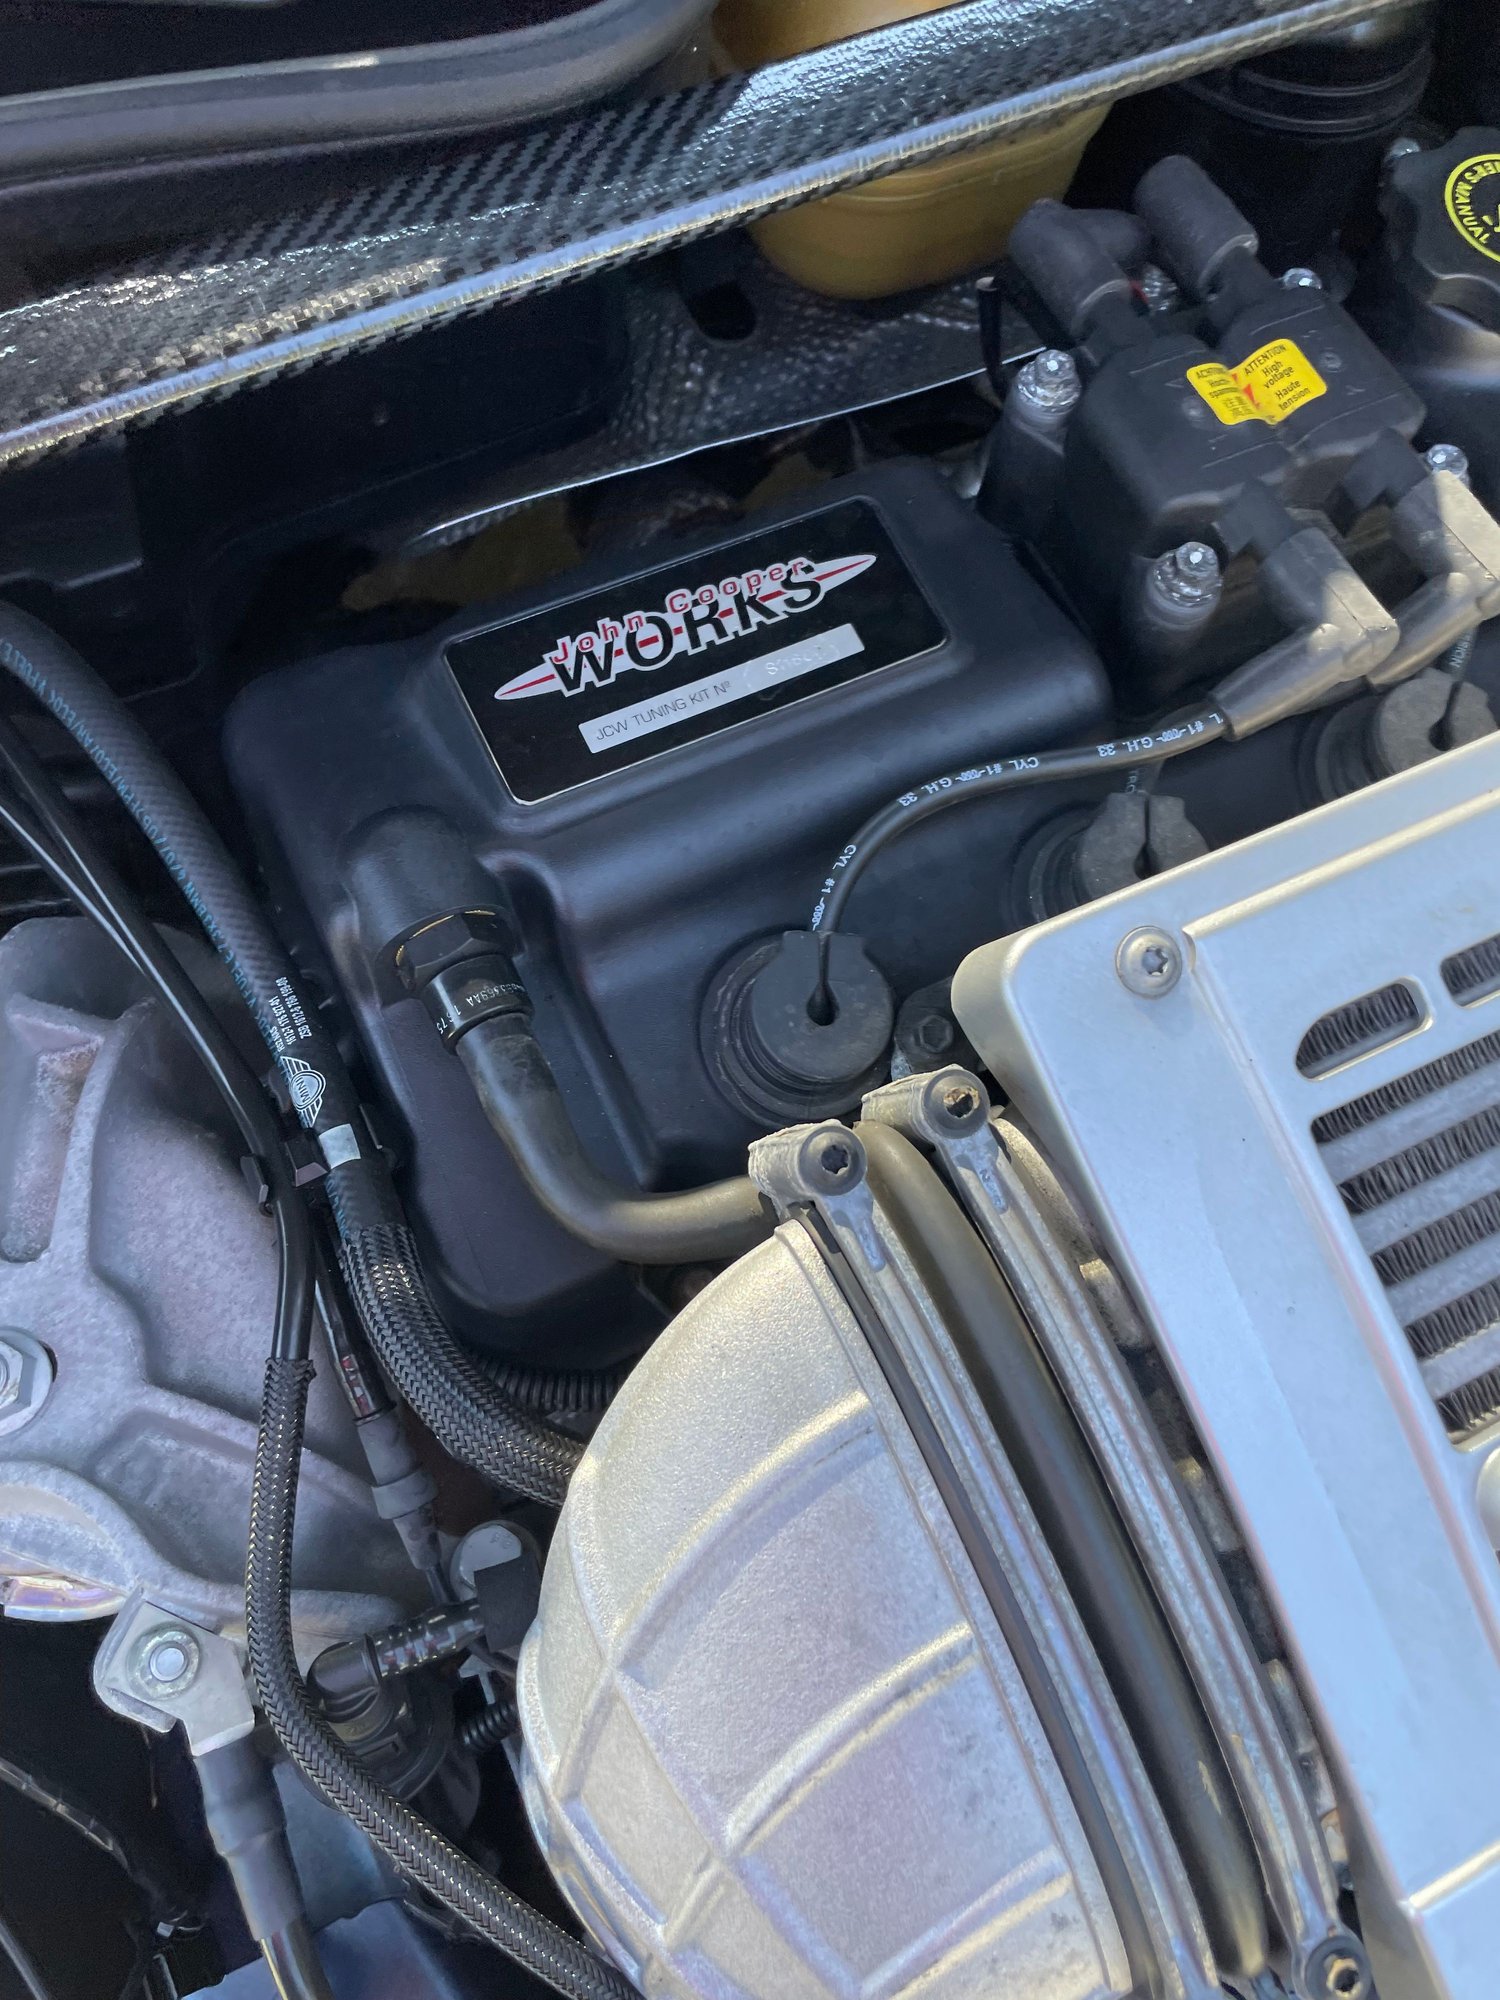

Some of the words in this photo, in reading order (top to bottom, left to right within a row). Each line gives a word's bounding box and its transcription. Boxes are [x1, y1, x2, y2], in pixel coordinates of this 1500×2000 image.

[1455, 181, 1490, 244] MANUAL
[1244, 344, 1287, 375] ATTENTION
[1262, 360, 1283, 376] High
[1264, 366, 1294, 389] voltage
[1275, 380, 1301, 400] Haute
[1278, 387, 1311, 411] tension
[554, 614, 644, 663] John
[669, 560, 804, 613] Cooper
[551, 564, 821, 691] WORKS
[596, 719, 628, 741] JCW
[633, 698, 687, 726] TUNING
[689, 688, 711, 706] KIT
[1187, 720, 1205, 735] #1
[1096, 743, 1116, 757] 33
[985, 763, 1002, 775] #1
[1008, 757, 1039, 771] CYL
[897, 791, 918, 807] 33
[832, 844, 857, 870] CYL
[821, 877, 836, 894] #1
[295, 1076, 311, 1103] MINI
